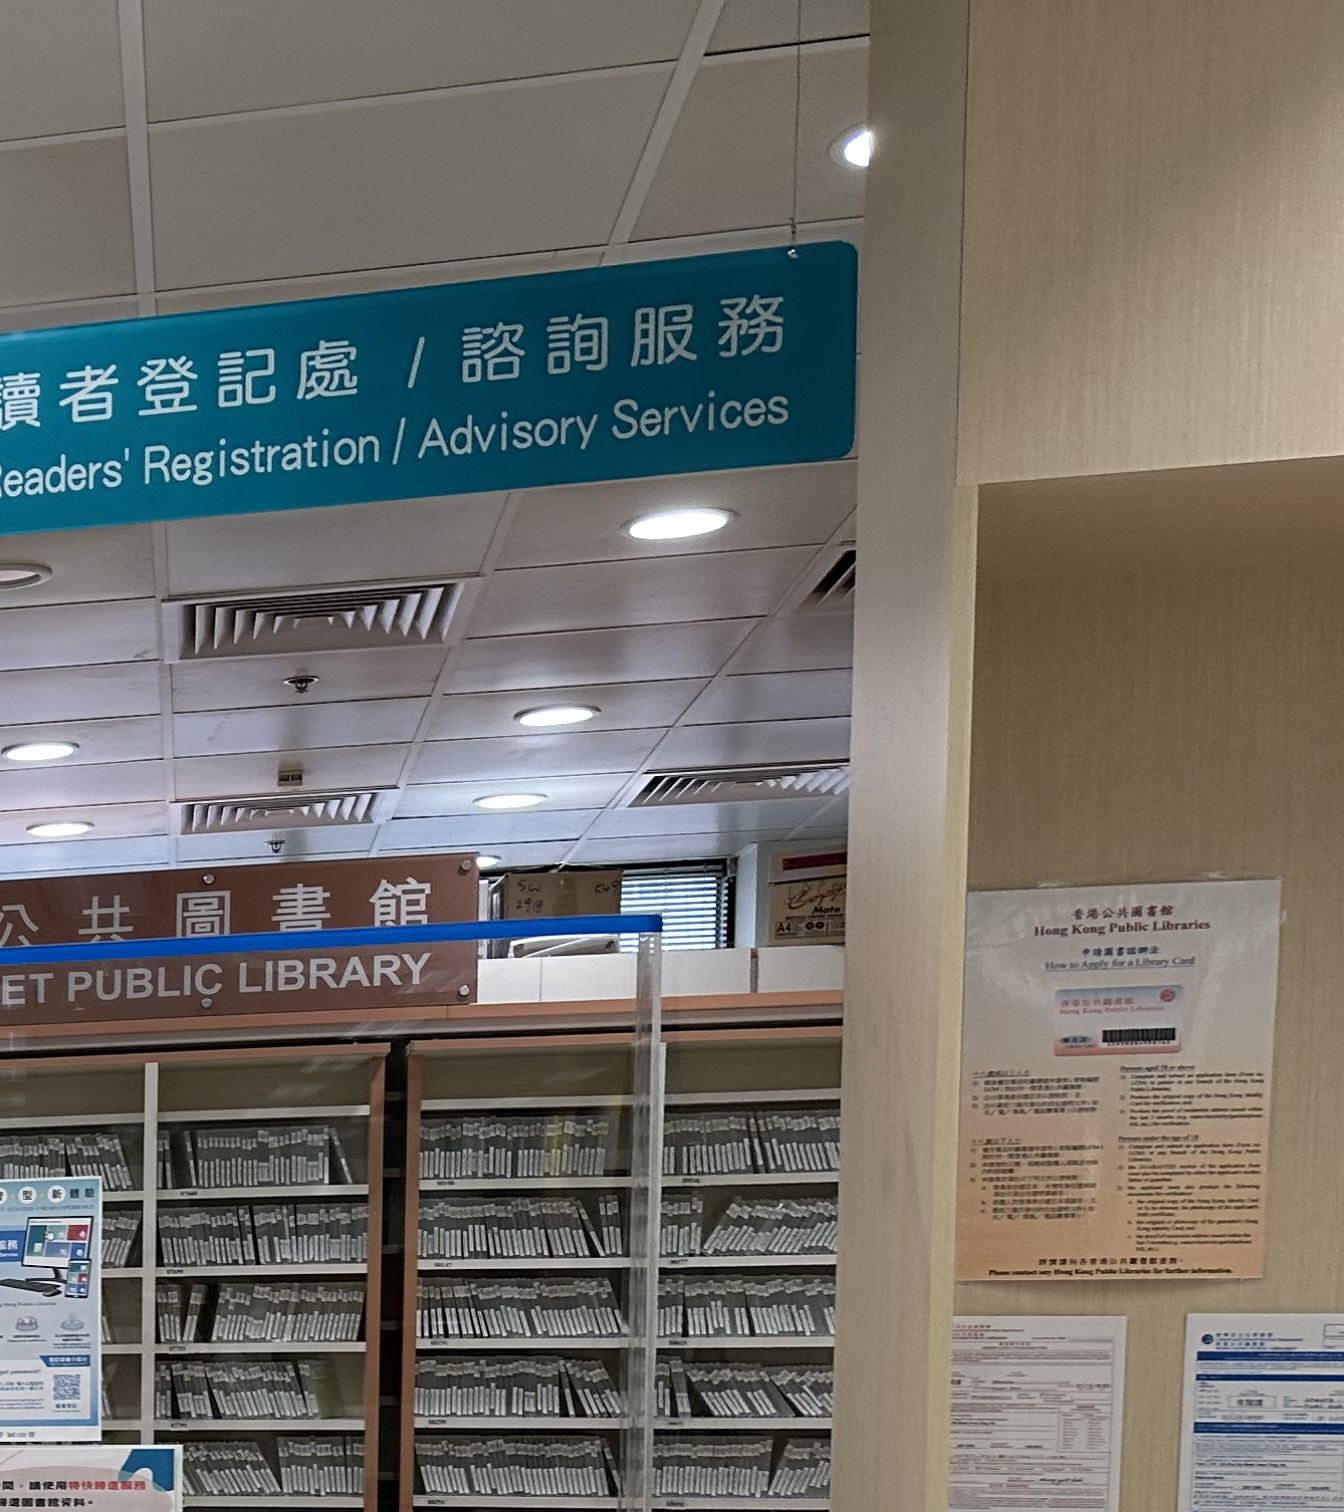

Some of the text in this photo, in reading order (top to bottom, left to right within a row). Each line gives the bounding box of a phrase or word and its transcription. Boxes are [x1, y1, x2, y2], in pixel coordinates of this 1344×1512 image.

[460, 292, 786, 385] 諮詢服務
[143, 424, 380, 488] Registration
[418, 409, 593, 464] Advisory
[611, 391, 789, 440] Services
[1073, 905, 1174, 921] 香港公共圖書館
[777, 922, 791, 933] A4
[1034, 920, 1210, 937] Hong Kong Public Libraries
[1081, 959, 1109, 970] Apply
[1136, 956, 1169, 968] Library
[67, 963, 223, 1003] PUBLIC
[238, 952, 432, 993] LIBRARY
